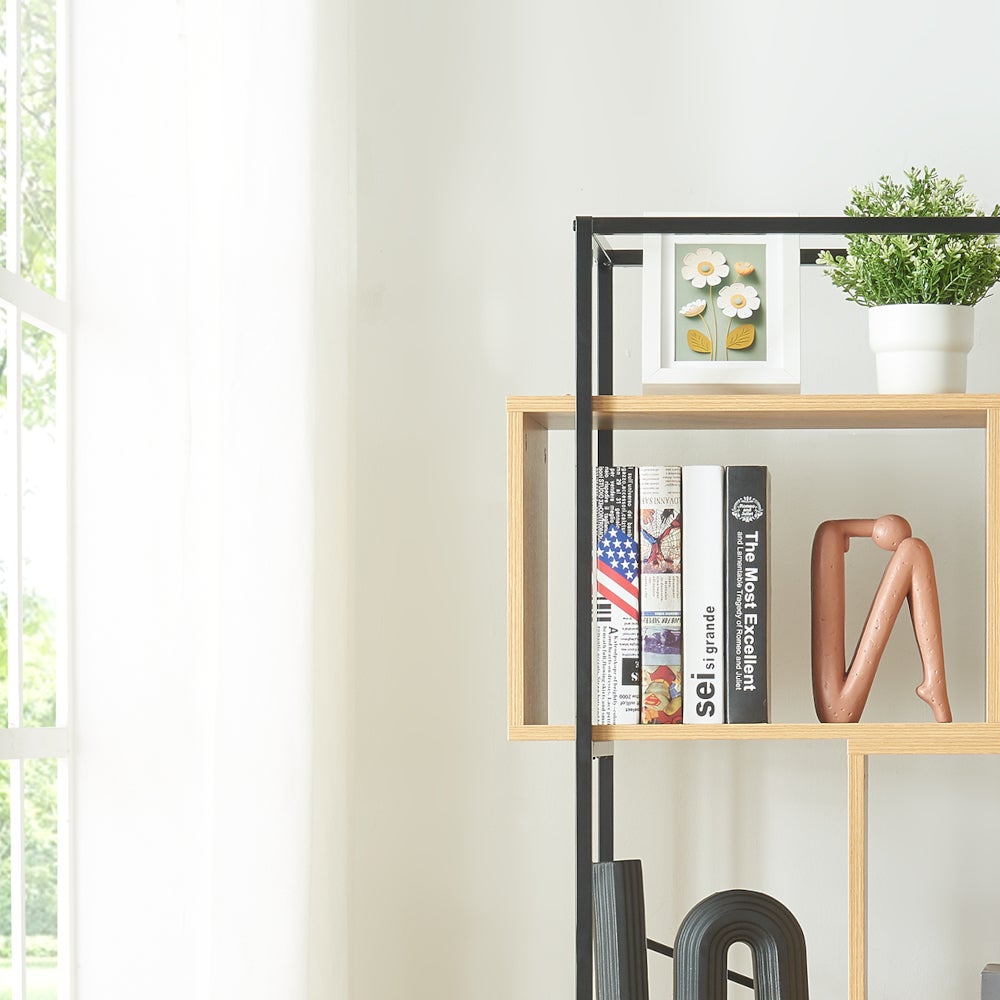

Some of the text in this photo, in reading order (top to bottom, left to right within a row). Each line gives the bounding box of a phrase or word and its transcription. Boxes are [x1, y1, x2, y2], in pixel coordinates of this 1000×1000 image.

[744, 531, 759, 562] The
[734, 531, 744, 691] and Lamentable Tragedy of Romeo and Juliet
[743, 567, 758, 609] Most
[703, 606, 718, 654] grande
[742, 613, 758, 692] Excellent
[691, 673, 716, 718] sei
